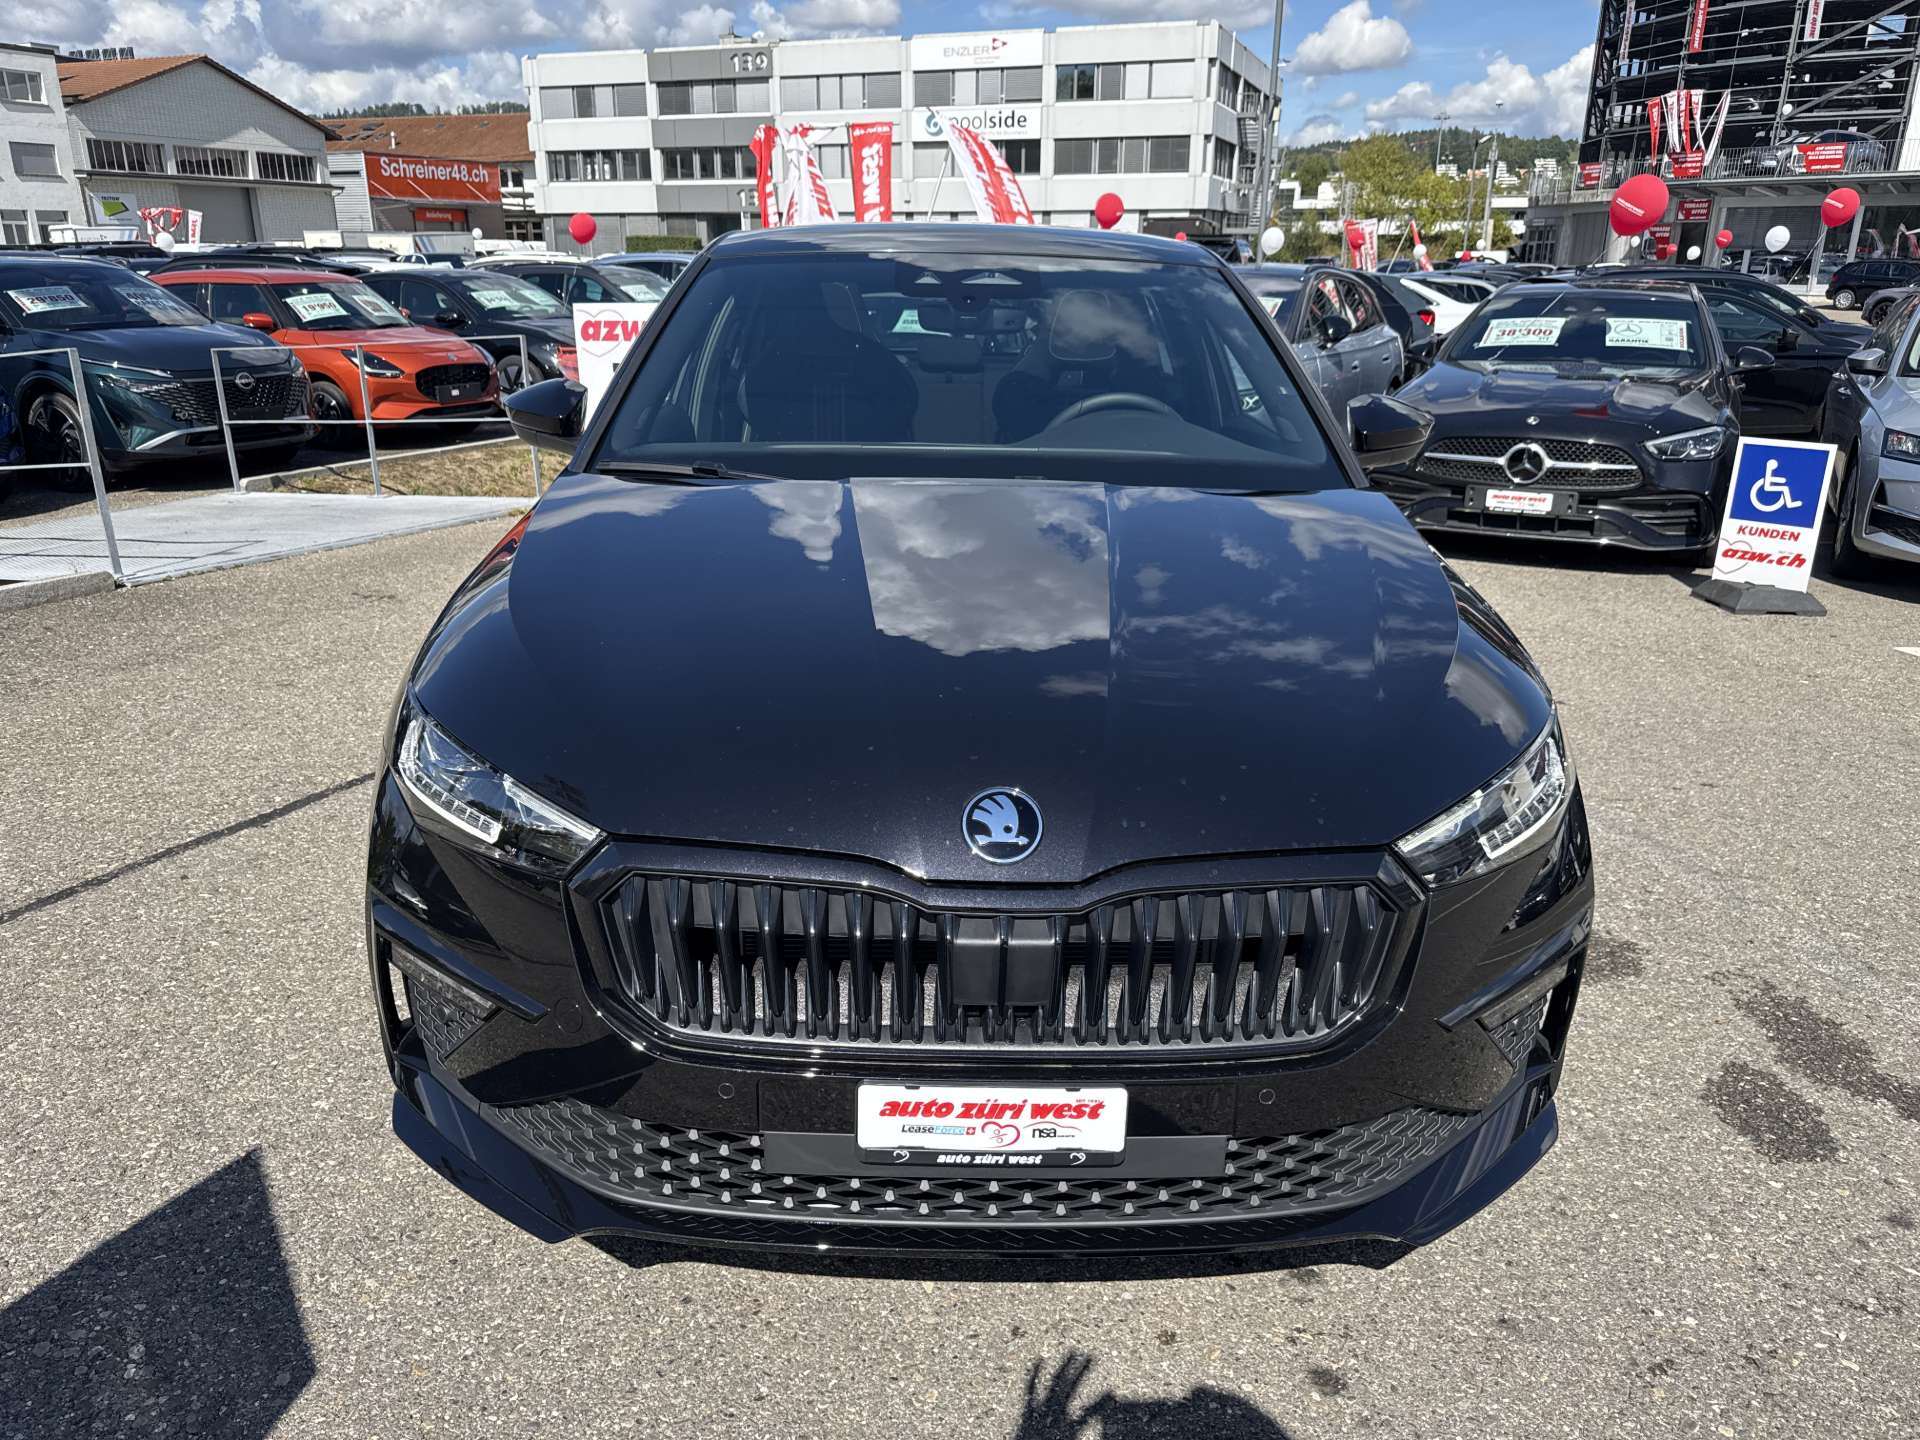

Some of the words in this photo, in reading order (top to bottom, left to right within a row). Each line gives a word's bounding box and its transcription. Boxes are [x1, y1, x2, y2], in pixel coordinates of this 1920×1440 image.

[943, 46, 990, 57] ENZLER
[730, 51, 769, 73] 139
[380, 156, 489, 183] Schreiner48.ch
[1737, 525, 1801, 542] KUNDEN
[1721, 548, 1807, 568] azw.ch
[879, 1098, 955, 1118] auto
[956, 1098, 1028, 1119] züri
[1030, 1100, 1106, 1120] west
[901, 1124, 965, 1136] LeaseForce
[1032, 1127, 1057, 1138] nsa
[936, 1154, 971, 1164] auto
[973, 1154, 1005, 1164] züri
[1008, 1154, 1043, 1165] west
